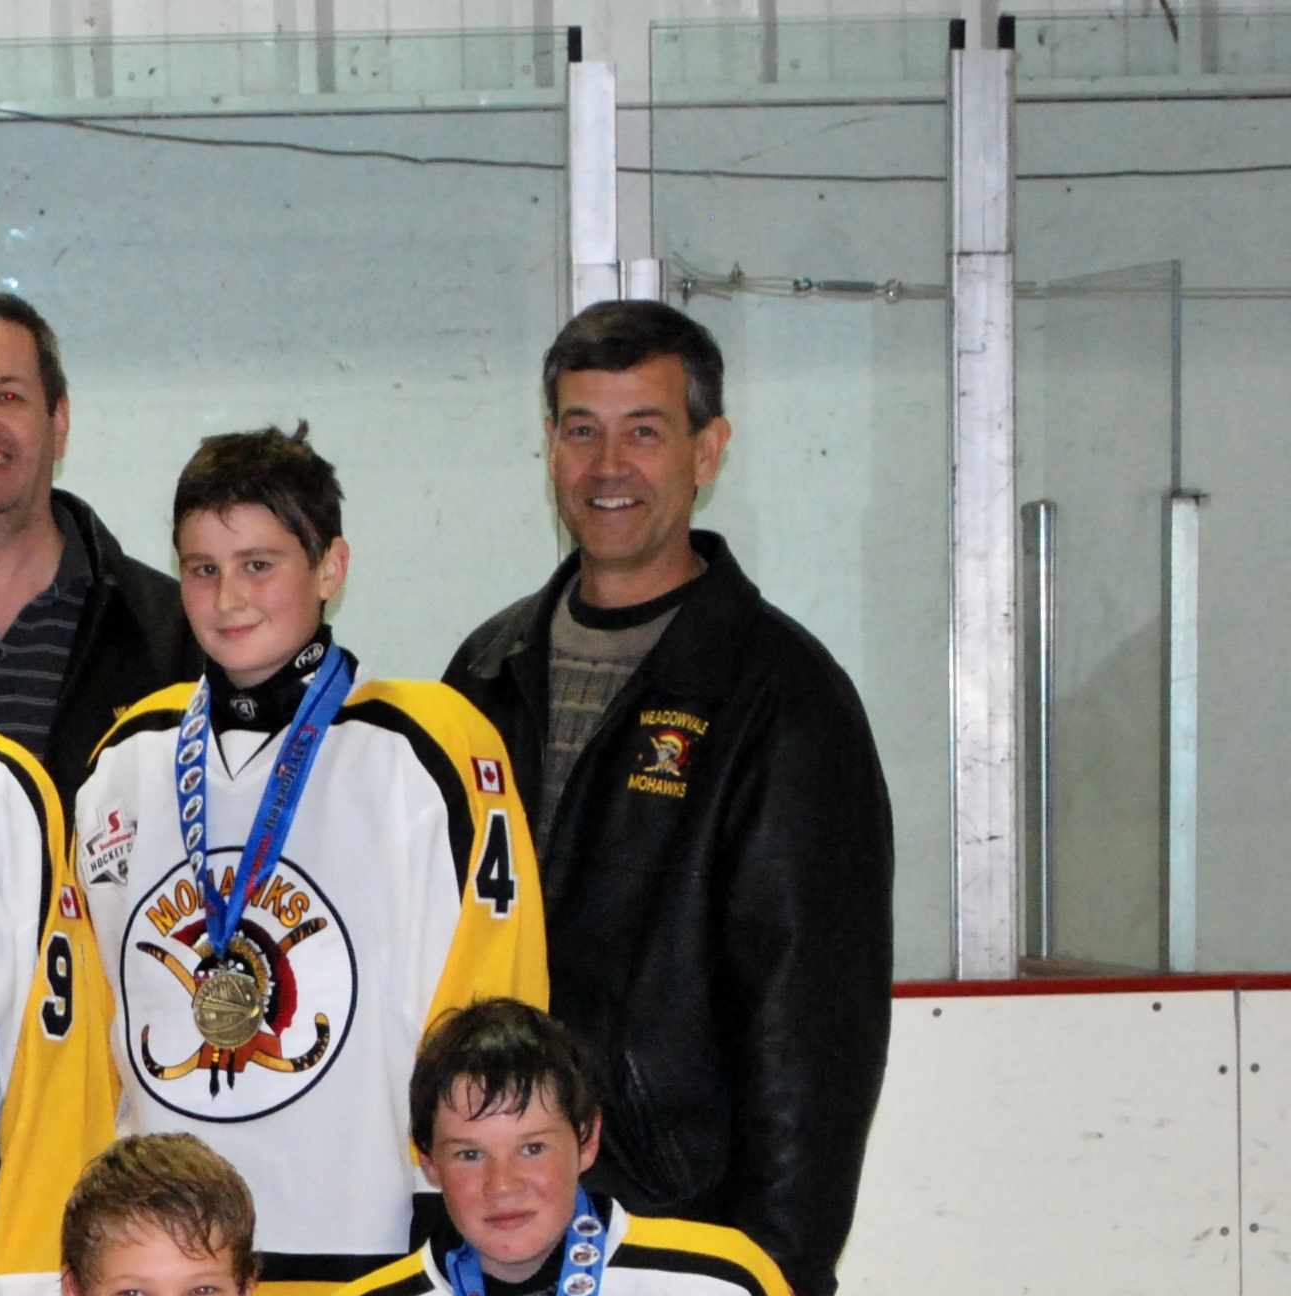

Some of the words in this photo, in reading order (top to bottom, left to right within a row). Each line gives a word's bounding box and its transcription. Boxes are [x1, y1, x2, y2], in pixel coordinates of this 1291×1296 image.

[640, 710, 710, 736] MEADOWVALE
[627, 773, 687, 799] MOHAWKS
[89, 843, 126, 873] HOCKEY
[474, 807, 517, 919] 4
[145, 866, 310, 937] MOAKS
[41, 930, 74, 1039] 9
